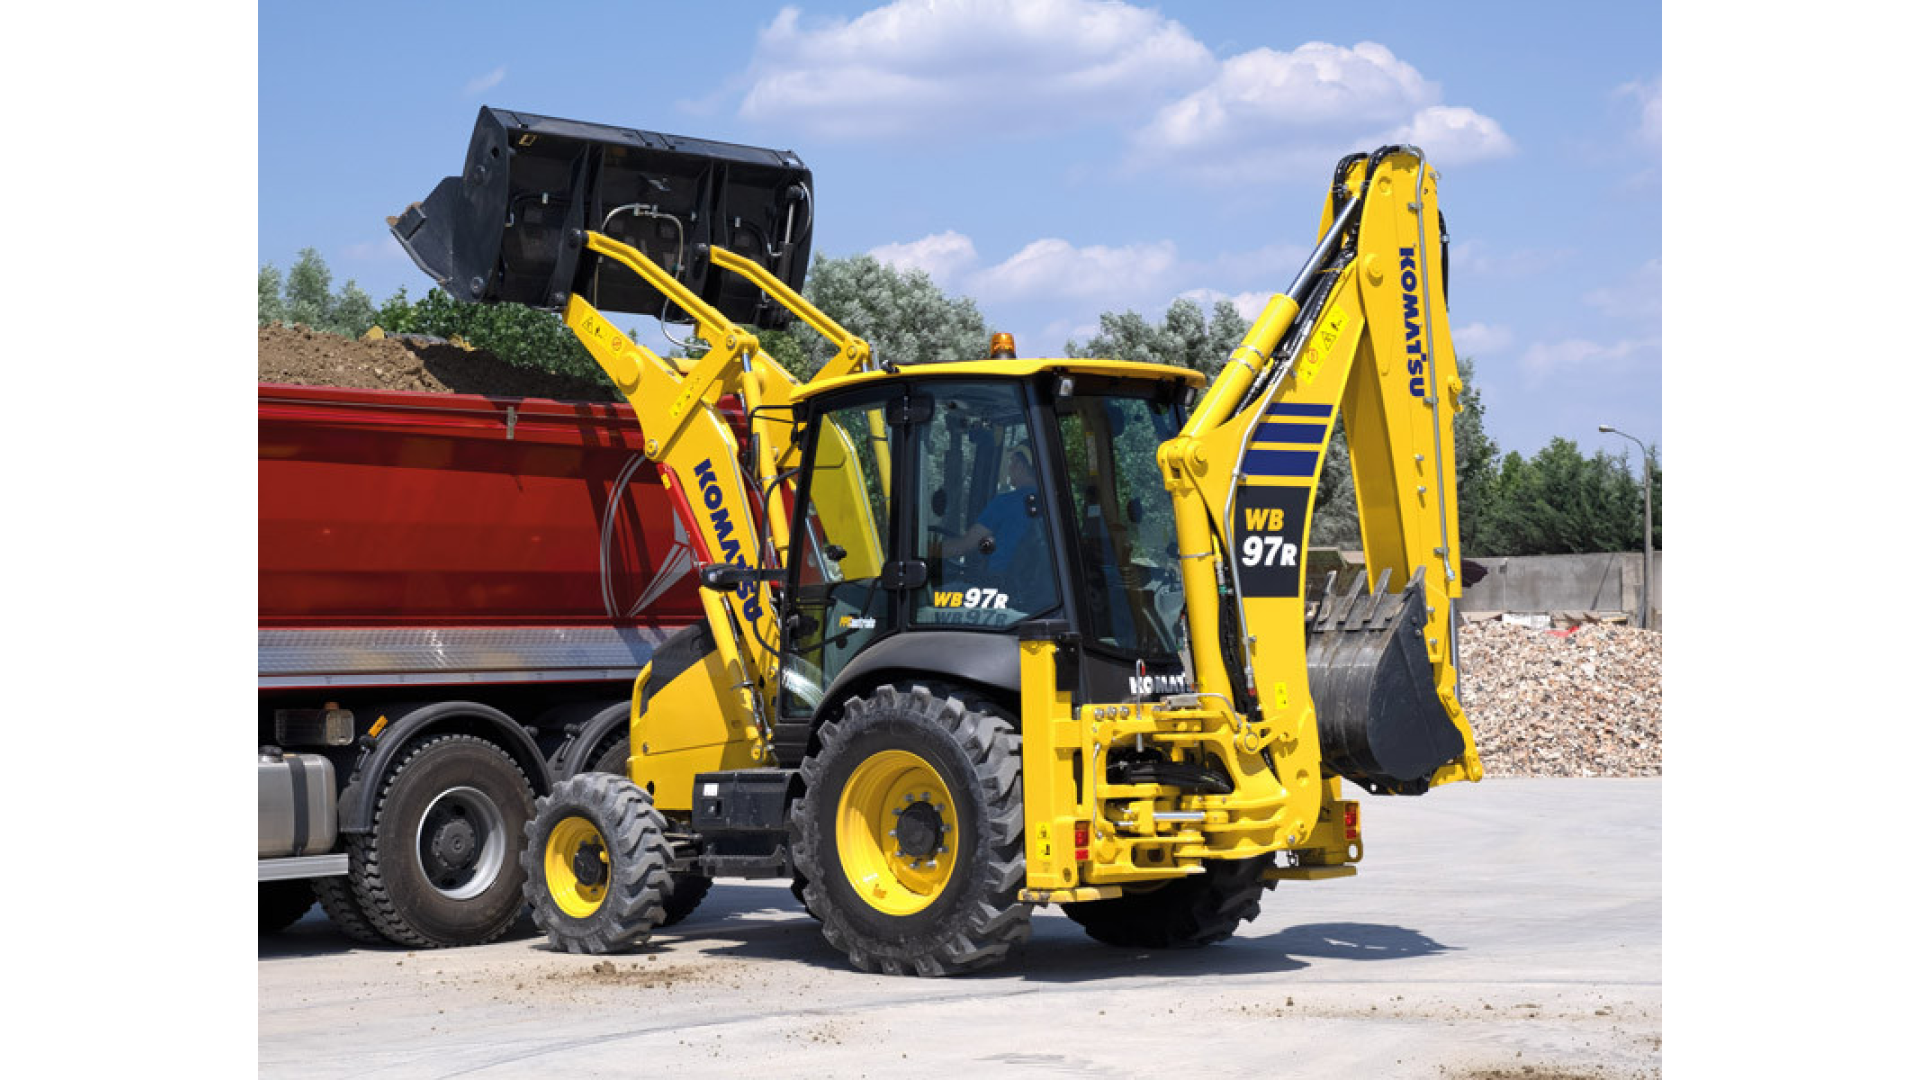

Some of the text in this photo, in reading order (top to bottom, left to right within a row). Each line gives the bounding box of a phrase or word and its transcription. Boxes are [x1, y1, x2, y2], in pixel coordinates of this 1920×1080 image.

[1399, 247, 1426, 397] KOMATSU
[1244, 508, 1285, 532] WB
[1241, 535, 1297, 566] 97R
[1128, 672, 1187, 695] KOMAT
